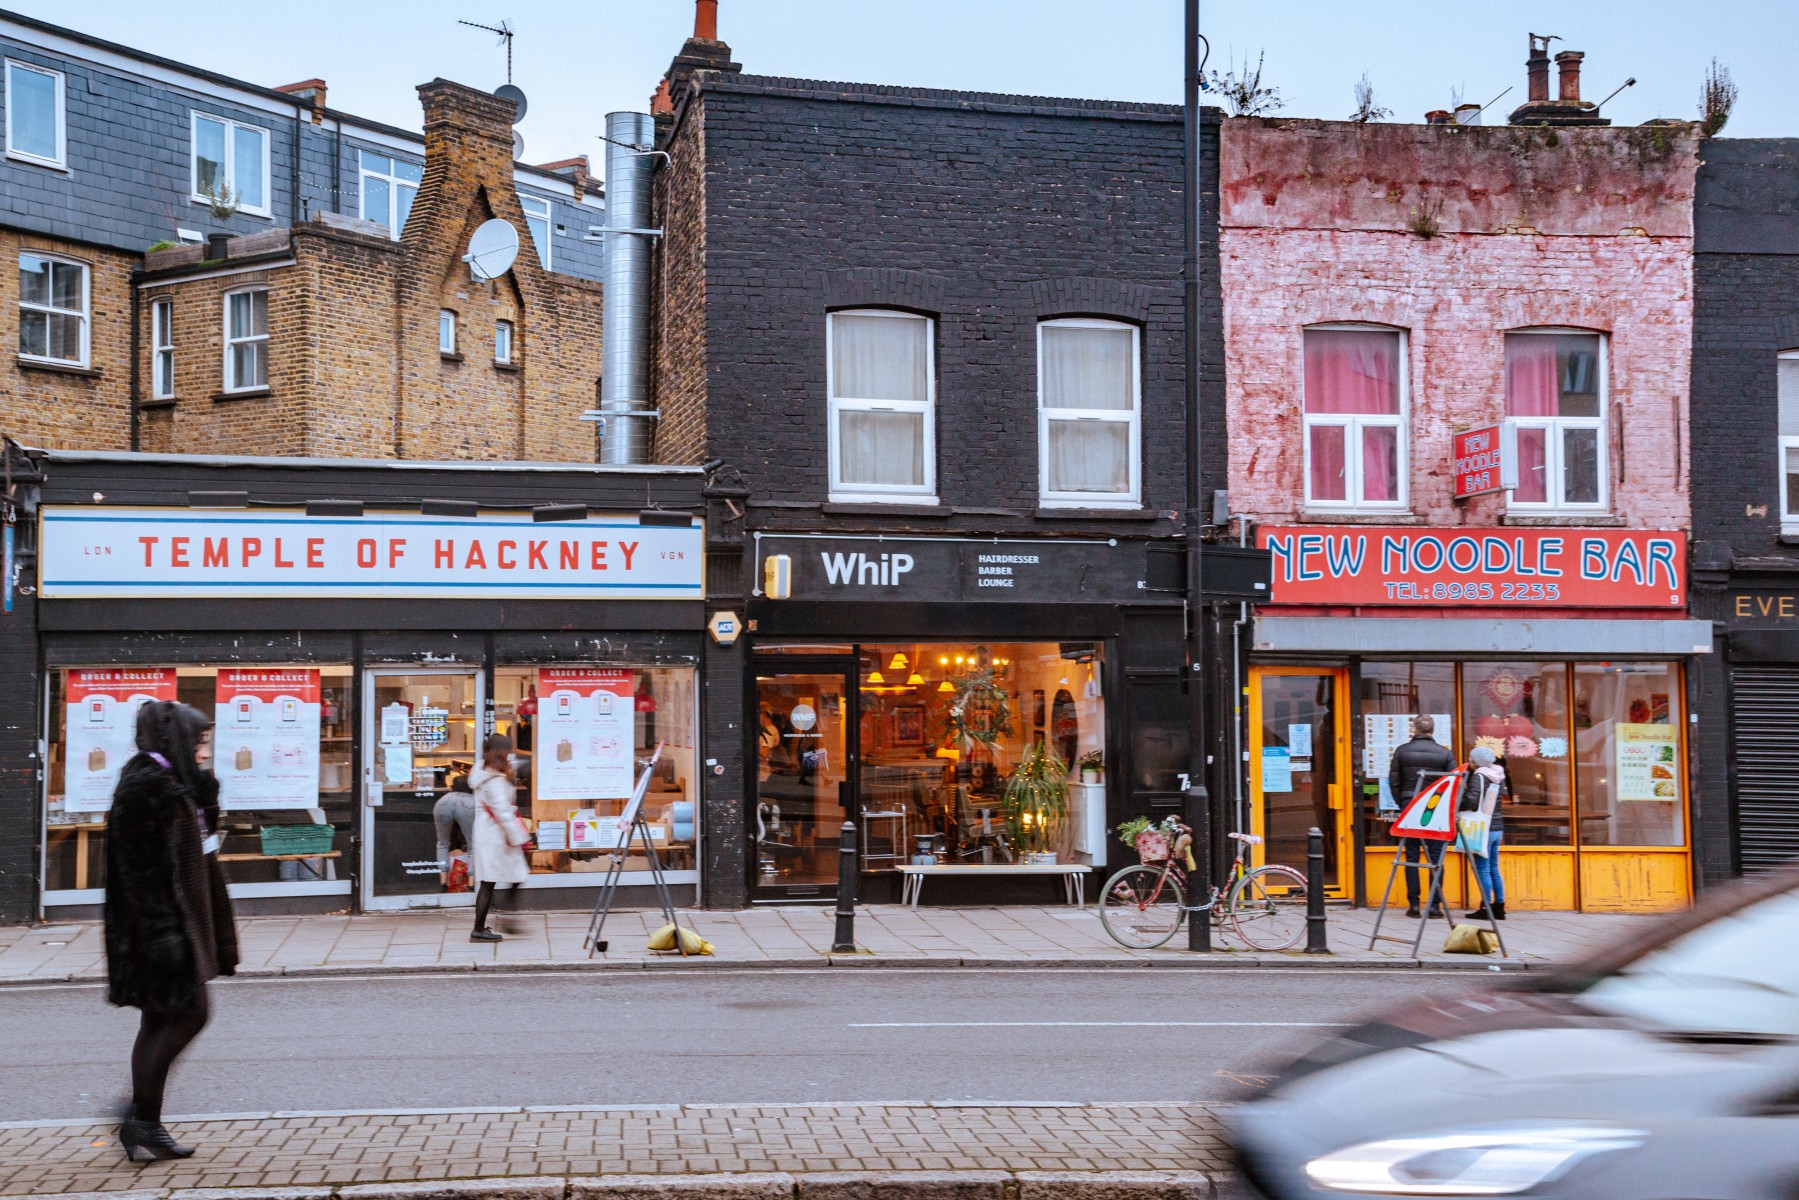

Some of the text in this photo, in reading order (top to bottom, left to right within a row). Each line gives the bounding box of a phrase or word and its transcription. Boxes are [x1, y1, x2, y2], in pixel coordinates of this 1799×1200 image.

[1464, 432, 1490, 454] NEW
[1456, 450, 1500, 475] NOODLE
[1466, 472, 1490, 492] BAR
[138, 536, 640, 571] TEMPLE OF HACKNEY
[660, 551, 684, 560] VGN
[978, 554, 1040, 564] HAIRDRESSER
[1267, 535, 1679, 590] NEW NOODLE BAR
[820, 552, 915, 586] WhiP
[978, 566, 1013, 575] BARBER
[978, 578, 1014, 587] LOUNGE
[1501, 582, 1560, 601] 2233
[1670, 595, 1679, 605] 9
[1735, 595, 1795, 617] EVE
[80, 673, 111, 681] ORDER
[123, 672, 164, 680] COLLECT
[229, 674, 259, 682] ORDER
[269, 674, 309, 682] COLLECT
